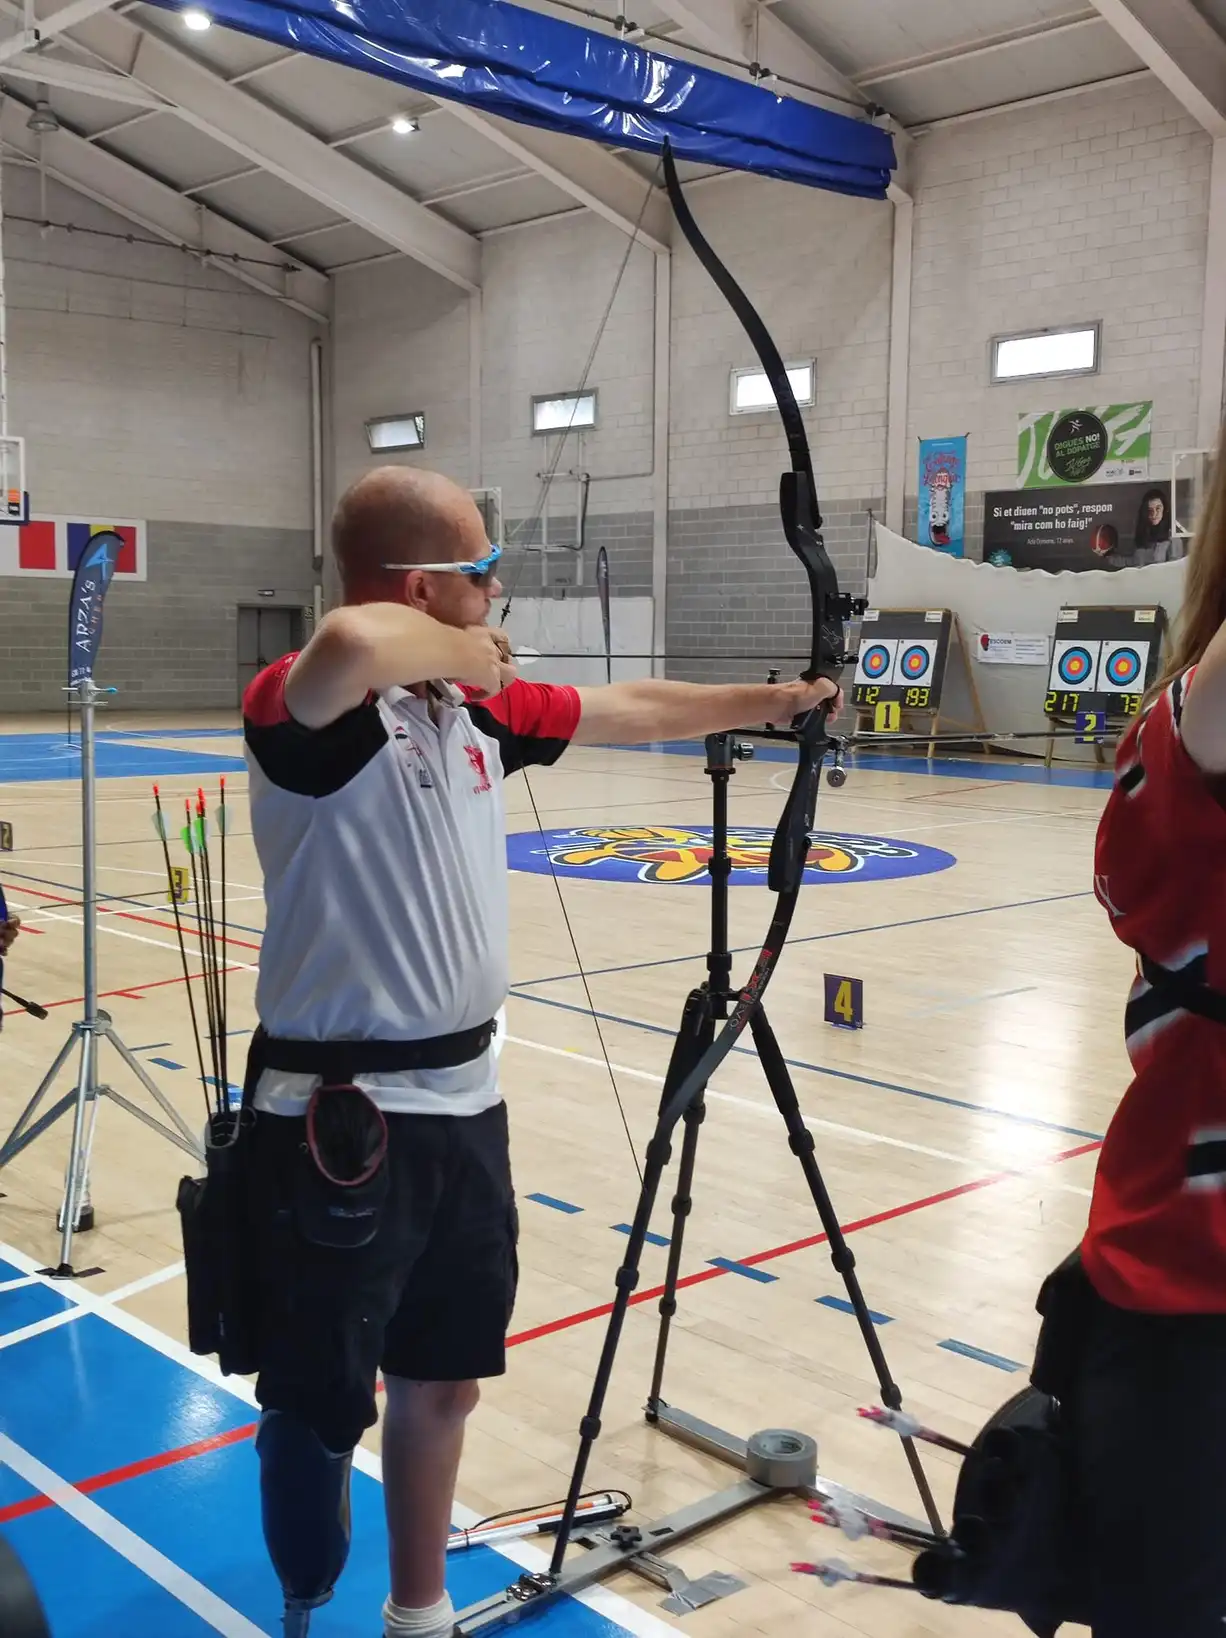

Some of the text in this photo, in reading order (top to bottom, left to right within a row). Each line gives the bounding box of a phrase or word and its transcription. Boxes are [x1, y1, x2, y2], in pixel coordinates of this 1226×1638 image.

[1054, 433, 1100, 450] DIGUES NO!
[1056, 450, 1066, 458] AL
[993, 506, 1002, 517] Si
[1003, 506, 1012, 517] et
[1014, 506, 1037, 516] diuen
[1082, 503, 1113, 515] respon
[1035, 521, 1053, 530] com
[1055, 518, 1066, 529] ho
[905, 687, 930, 707] 193
[1044, 691, 1079, 712] 217
[883, 704, 891, 729] 1
[1083, 714, 1097, 742] 2
[834, 980, 853, 1022] 4
